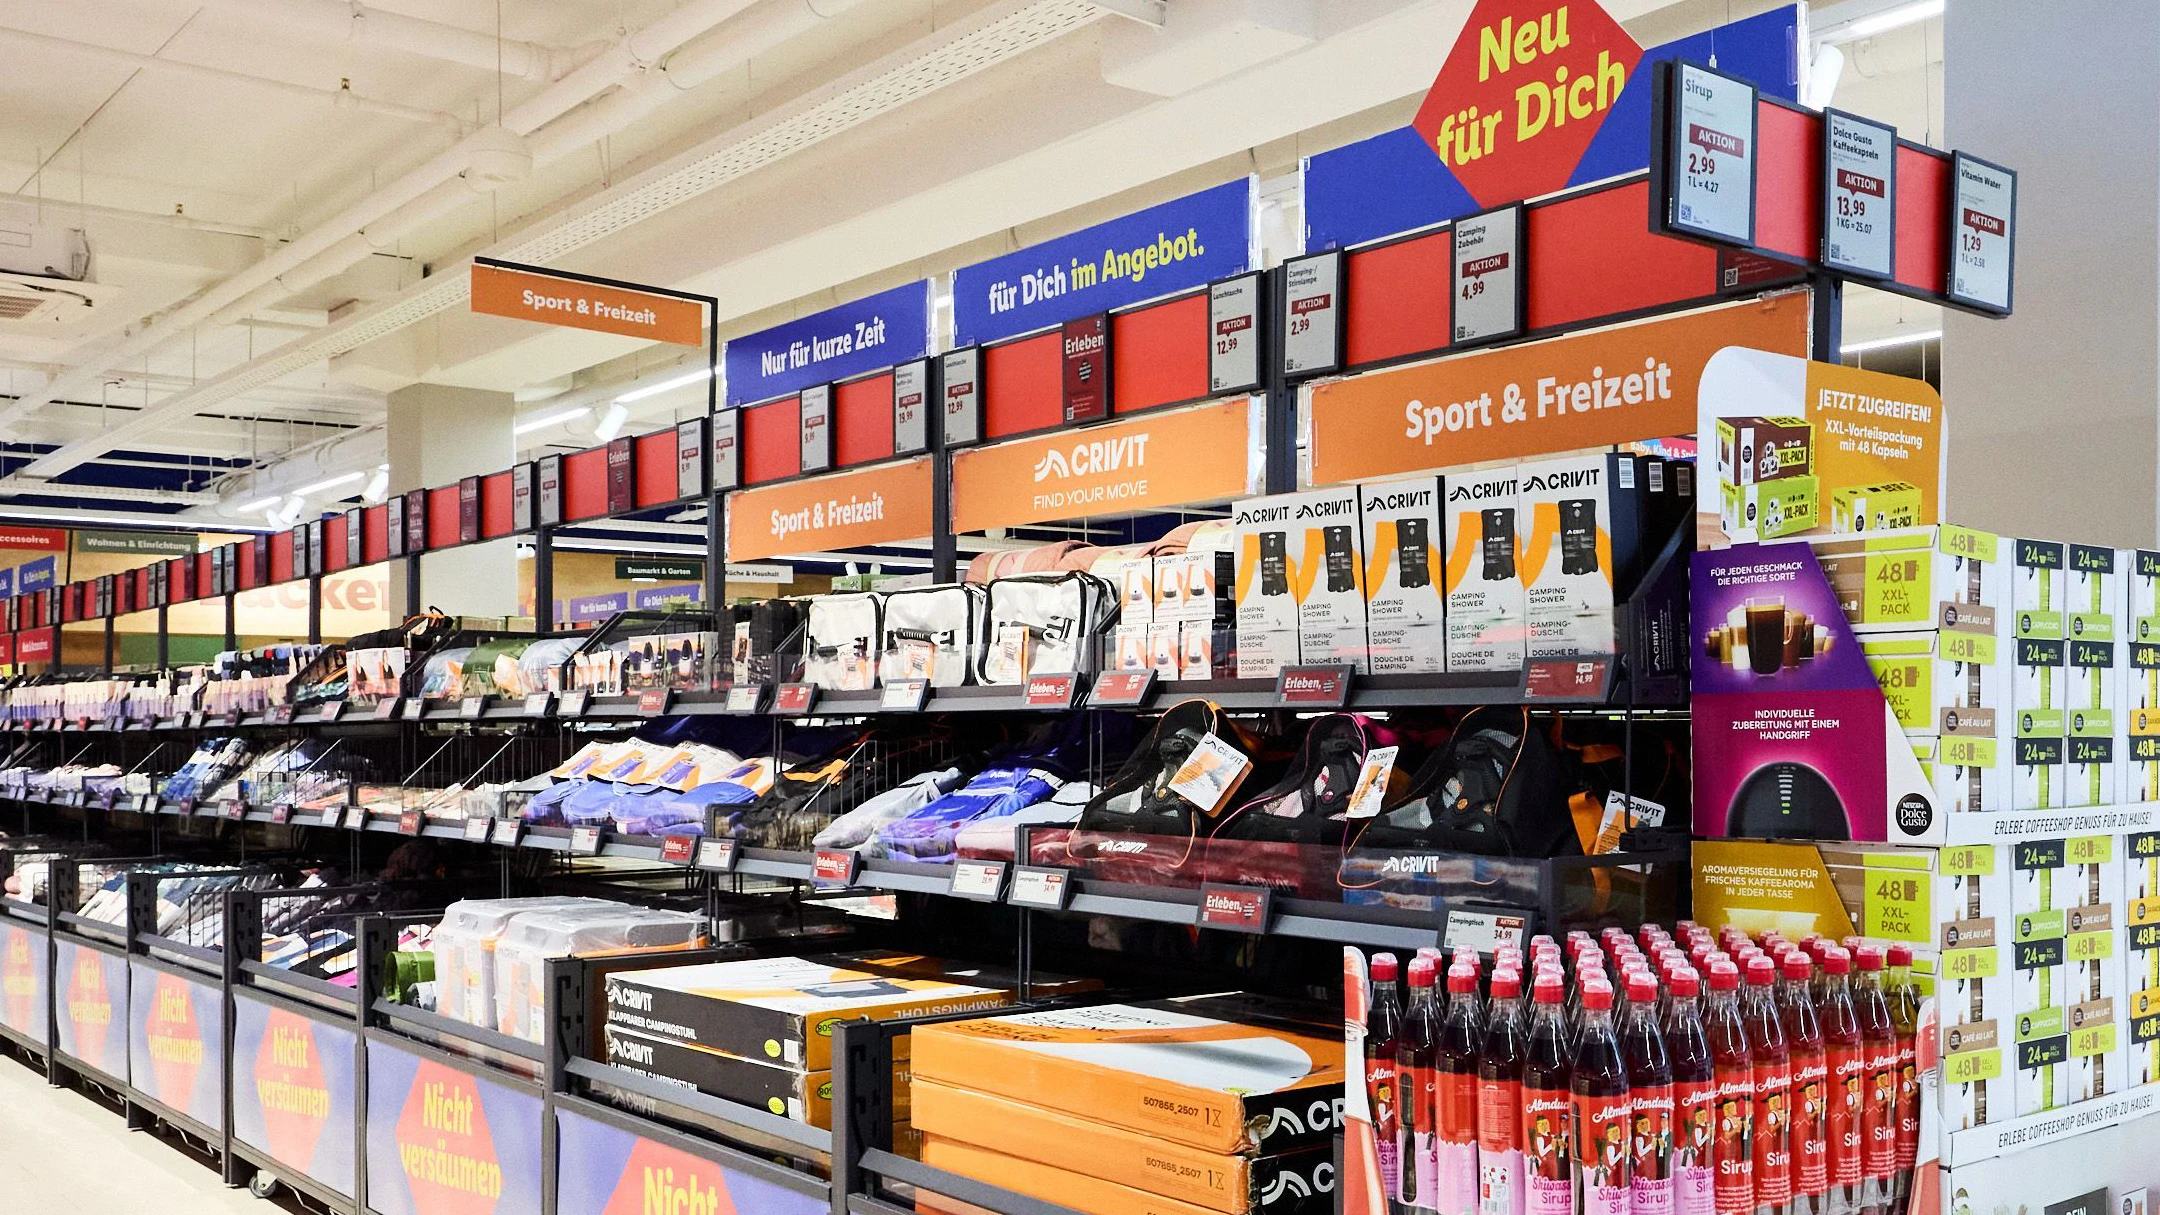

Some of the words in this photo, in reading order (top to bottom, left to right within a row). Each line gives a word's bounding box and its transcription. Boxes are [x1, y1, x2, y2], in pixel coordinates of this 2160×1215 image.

[1479, 6, 1570, 83] Neu
[1686, 79, 1713, 101] Sirup
[1437, 104, 1503, 167] für
[1515, 50, 1625, 143] Dich
[1698, 129, 1736, 151] AKTION
[1833, 126, 1852, 141] Dolce
[1853, 132, 1872, 146] Gusto
[1833, 139, 1879, 160] Kaffeekapseln
[1689, 153, 1715, 175] 2.99
[1688, 176, 1692, 187] 1
[1693, 177, 1697, 188] L
[1704, 181, 1719, 193] 4.27
[1844, 173, 1877, 191] AKTION
[1961, 168, 1983, 184] Vitamin
[1984, 176, 2001, 190] Water
[1837, 196, 1865, 217] 13.99
[1841, 218, 1850, 229] KG
[1856, 221, 1872, 234] 25.07
[1970, 213, 1998, 230] AKTION
[1458, 225, 1486, 239] Camping
[1458, 236, 1484, 250] Zubehör
[1963, 234, 1982, 252] 1.29
[989, 282, 1017, 314] für
[1022, 265, 1066, 306] Dich
[1071, 258, 1097, 292] im
[1101, 227, 1204, 283] Angebot.
[1469, 257, 1501, 273] AKTION
[1213, 287, 1243, 301] Lunchtasche
[1462, 281, 1485, 300] 4.99
[523, 289, 571, 311] Sport
[576, 300, 589, 315] &
[594, 302, 656, 326] Freizeit
[1298, 297, 1324, 310] AKTION
[1222, 319, 1247, 331] AKTION
[1291, 319, 1310, 336] 2.99
[762, 351, 787, 377] Nur
[790, 340, 810, 370] für
[812, 335, 852, 363] kurze
[856, 316, 885, 348] Zeit
[1065, 333, 1105, 355] Erleben
[1217, 338, 1237, 356] 12.99
[1406, 393, 1492, 445] Sport
[1501, 383, 1526, 424] &
[1537, 357, 1672, 418] Freizeit
[1816, 388, 1855, 412] JETZT
[1857, 394, 1932, 424] ZUGREIFEN!
[1825, 419, 1924, 451] XXL-Vorteilspackung
[1071, 433, 1149, 476] CRIVIT
[1653, 444, 1672, 457] Kind
[1674, 447, 1681, 457] &
[1780, 449, 1805, 464] XXL-PACK
[1840, 439, 1855, 452] mit
[1857, 441, 1870, 454] 48
[1872, 442, 1909, 462] Kapseln
[1547, 468, 1600, 489] CRIVIT
[1034, 493, 1064, 510] FIND
[1066, 486, 1103, 506] YOUR
[1107, 480, 1147, 499] MOVE
[1387, 490, 1431, 510] CRIVIT
[771, 508, 809, 538] Sport
[812, 502, 824, 529] &
[828, 492, 884, 526] Freizeit
[1315, 499, 1353, 517] CRIVIT
[87, 538, 128, 547] Wohnen
[129, 540, 136, 548] &
[138, 540, 191, 552] Einrichtung
[1950, 534, 1966, 551] 48
[2025, 545, 2039, 563] 24
[627, 566, 659, 576] Baumarkt
[661, 567, 667, 575] &
[668, 567, 691, 576] Garten
[1710, 565, 1729, 577] FÜR
[1731, 565, 1752, 575] JEDEN
[1753, 561, 1803, 574] GESCHMACK
[2143, 556, 2155, 572] 24
[1717, 576, 1730, 586] DIE
[1731, 574, 1767, 585] RICHTIGE
[1768, 571, 1796, 582] SORTE
[1877, 562, 1902, 584] 48
[1371, 599, 1404, 608] CAMPING
[1882, 590, 1909, 601] XXL-
[1372, 606, 1402, 615] SHOWER
[1881, 601, 1910, 615] PACK
[1373, 630, 1408, 638] CAMPING-
[1373, 637, 1401, 645] DUSCHE
[1374, 655, 1401, 663] DOUCHE
[1507, 651, 1521, 660] 25L
[1374, 663, 1407, 671] CAMPING
[1284, 678, 1322, 692] Erleben,
[1574, 674, 1593, 685] 14.99
[1755, 709, 1815, 719] INDIVIDUELLE
[1732, 719, 1792, 731] ZUBEREITUNG
[1794, 719, 1809, 730] MIT
[1811, 719, 1840, 730] EINEM
[1759, 730, 1811, 740] HANDGRIFF
[1216, 745, 1244, 766] CRIVIT
[1629, 801, 1662, 817] CRIVIT
[1900, 808, 1927, 820] Dolce
[1900, 816, 1928, 828] Gusto
[1994, 819, 2024, 835] ERLEBE
[2026, 817, 2072, 833] COFFEESHOP
[2075, 815, 2101, 830] GENUSS
[2103, 812, 2117, 828] FÜR
[2118, 814, 2127, 827] ZU
[2129, 811, 2152, 825] HAUSE!
[1400, 855, 1439, 874] CRIVIT
[1701, 864, 1797, 878] AROMAVERSIEGELUNG
[1799, 867, 1819, 878] FÜR
[1705, 875, 1745, 886] FRISCHES
[1747, 877, 1815, 889] KAFFEEAROMA
[1877, 879, 1902, 901] 48
[1725, 887, 1734, 896] IN
[1735, 888, 1763, 898] JEDER
[1765, 889, 1793, 899] TASSE
[1206, 894, 1242, 912] Erleben,
[1449, 915, 1485, 927] Campingtisch
[1882, 907, 1910, 919] XXL-
[1500, 918, 1520, 927] AKTION
[1881, 921, 1911, 934] PACK
[1494, 929, 1512, 940] 34.99
[159, 989, 188, 1024] Nicht
[622, 988, 653, 1012] CRIVIT
[609, 1009, 646, 1027] KLAPPBARER
[646, 1018, 698, 1040] CAMPINGSTUHL
[147, 1029, 203, 1065] versäumen
[273, 1027, 309, 1069] Nicht
[623, 1041, 654, 1066] CRIVIT
[1956, 1059, 1971, 1076] 48
[257, 1073, 331, 1120] versäumen
[423, 1082, 474, 1136] Nicht
[1143, 1096, 1199, 1118] 507855_2507
[1998, 1129, 2026, 1147] ERLEBE
[2028, 1117, 2075, 1142] COFFEESHOP
[2077, 1107, 2104, 1128] GENUSS
[2105, 1102, 2119, 1119] FÜR
[2120, 1100, 2129, 1116] ZU
[2130, 1094, 2153, 1113] HAUSE!
[400, 1138, 501, 1200] versäumen
[1638, 1191, 1670, 1206] Sirup
